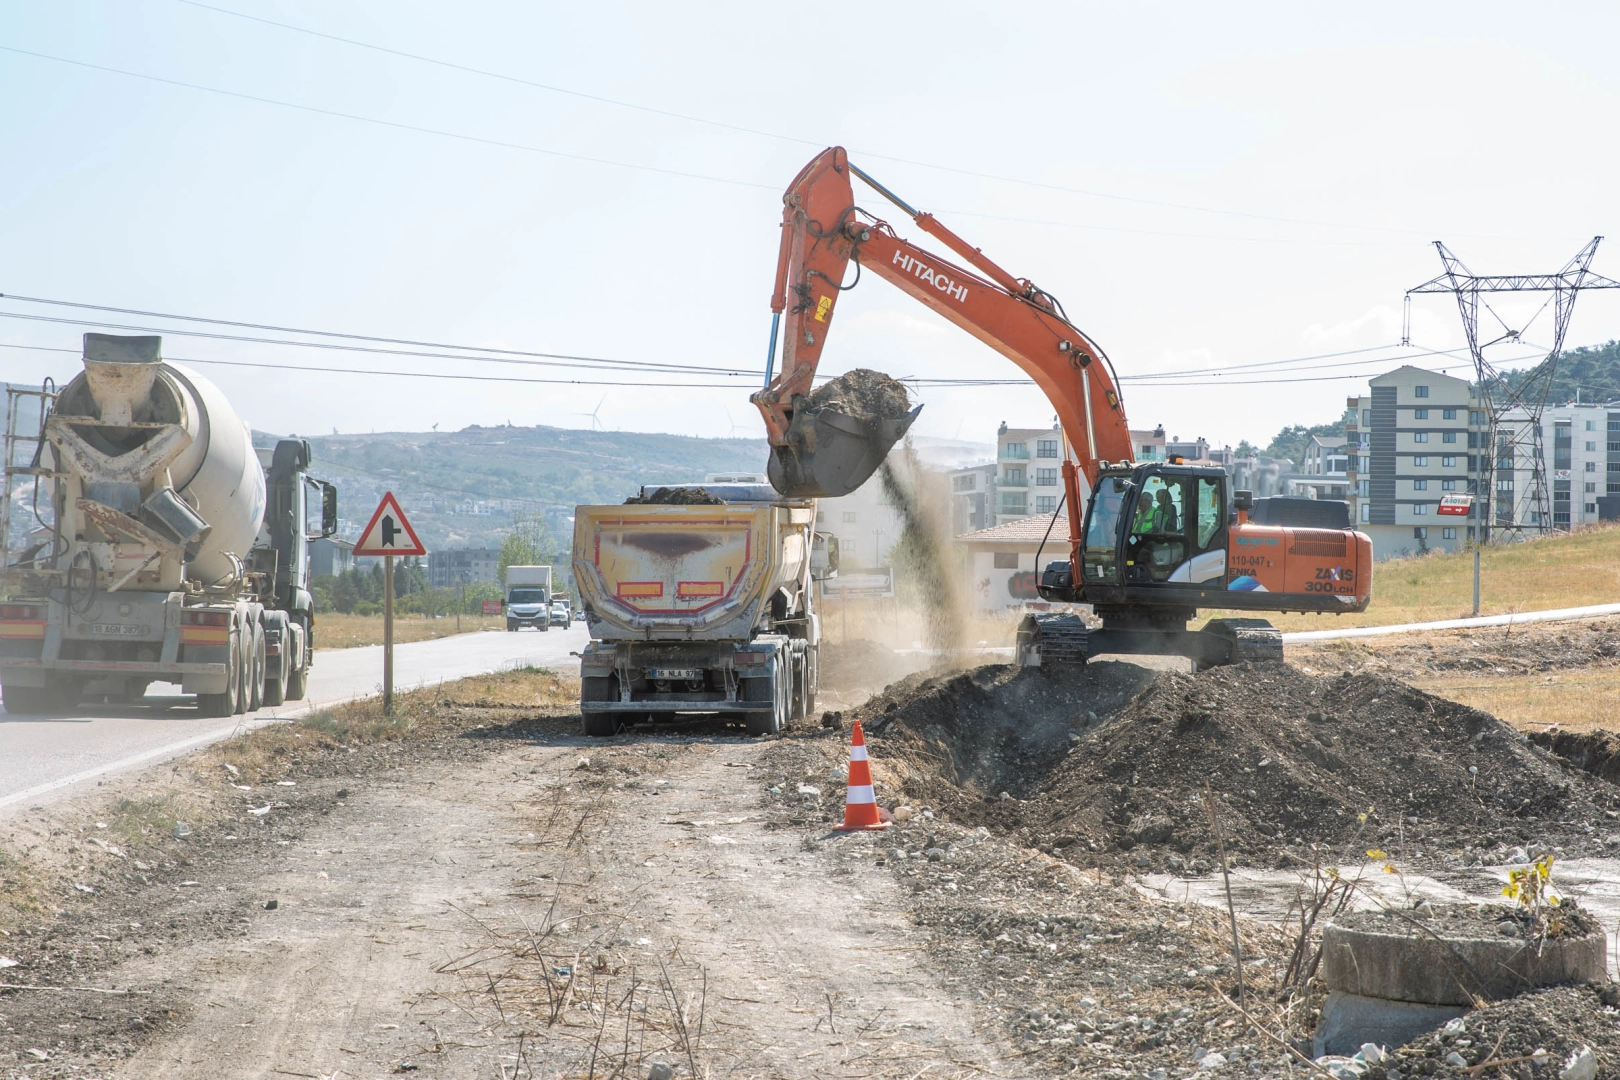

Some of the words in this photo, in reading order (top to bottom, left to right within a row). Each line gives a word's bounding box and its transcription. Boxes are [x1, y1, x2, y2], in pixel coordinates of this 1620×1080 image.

[892, 249, 969, 303] HITACHI
[1231, 555, 1265, 566] 110-047
[1229, 567, 1257, 577] ENKA
[1315, 565, 1354, 582] ZAXIS
